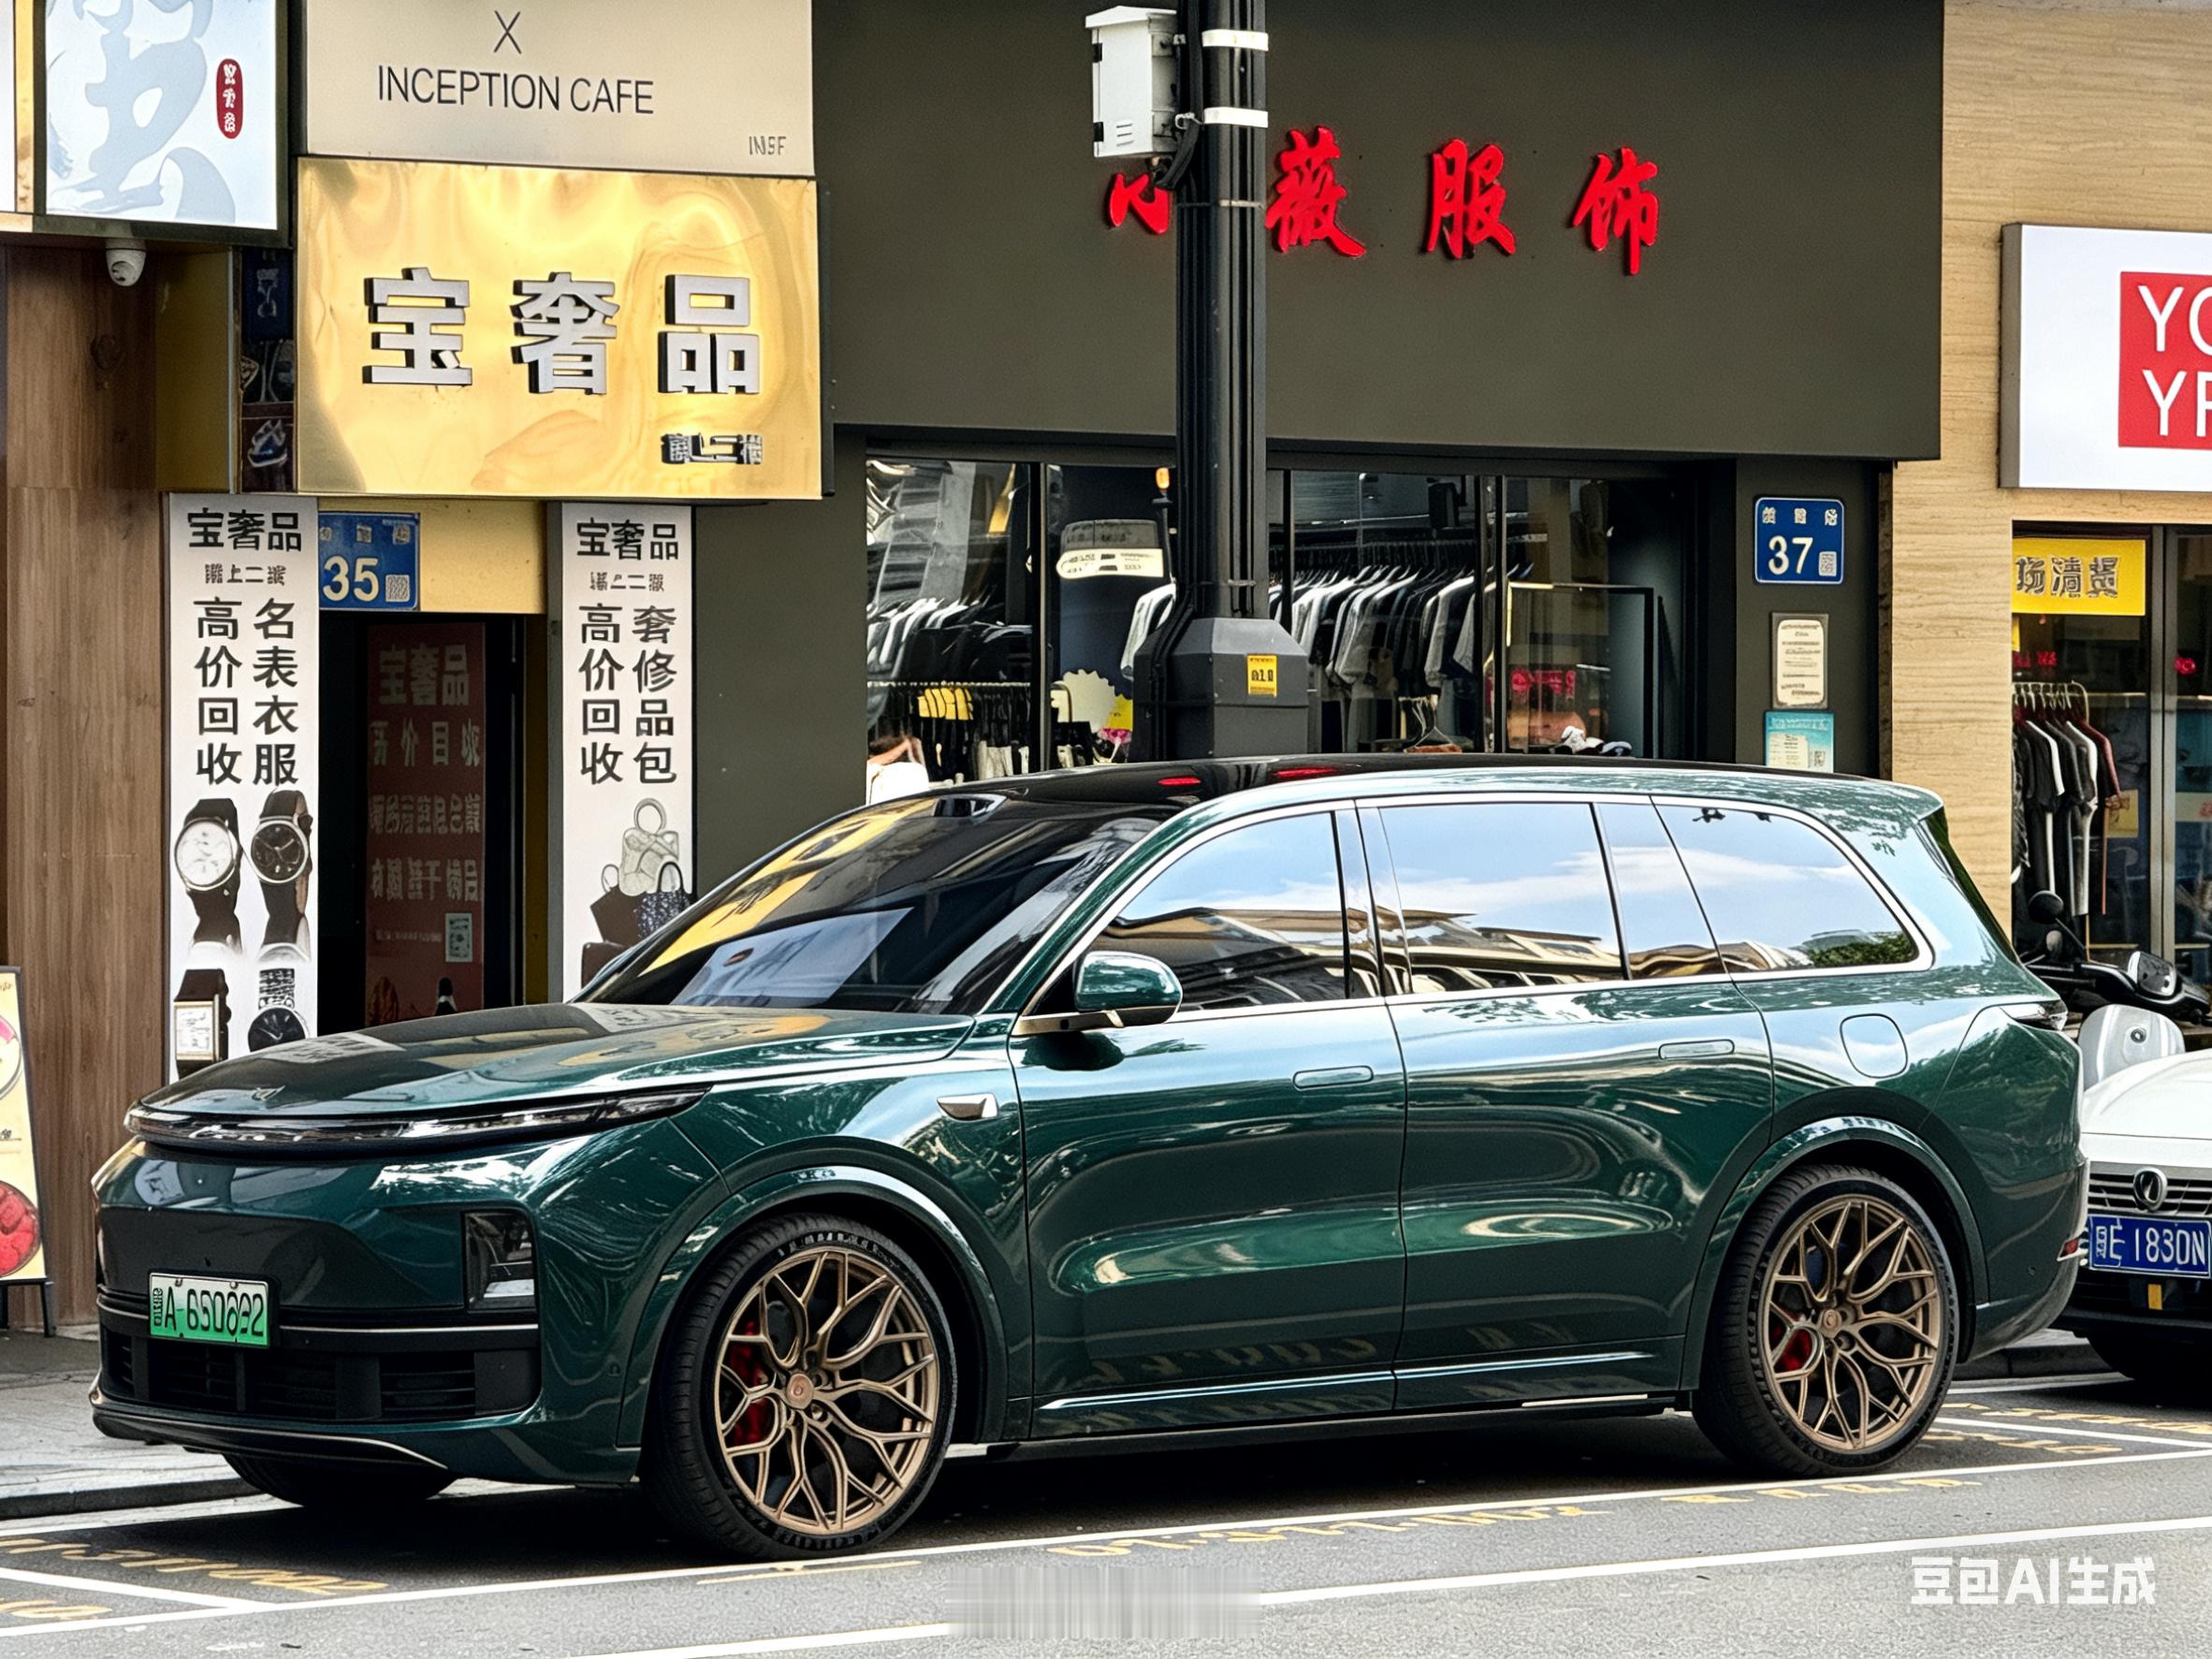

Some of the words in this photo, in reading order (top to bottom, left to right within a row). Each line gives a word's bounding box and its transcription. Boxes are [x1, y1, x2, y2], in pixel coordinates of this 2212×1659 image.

[378, 65, 560, 110] INCEPTION
[570, 78, 654, 113] CAFE
[362, 267, 761, 395] 宝奢品
[187, 507, 301, 552] 宝奢品
[576, 517, 678, 560] 宝奢品
[323, 556, 379, 602] 35
[1768, 535, 1813, 575] 37
[193, 596, 242, 785] 高价回收
[253, 597, 299, 786] 名表衣服
[578, 603, 624, 785] 高价回收
